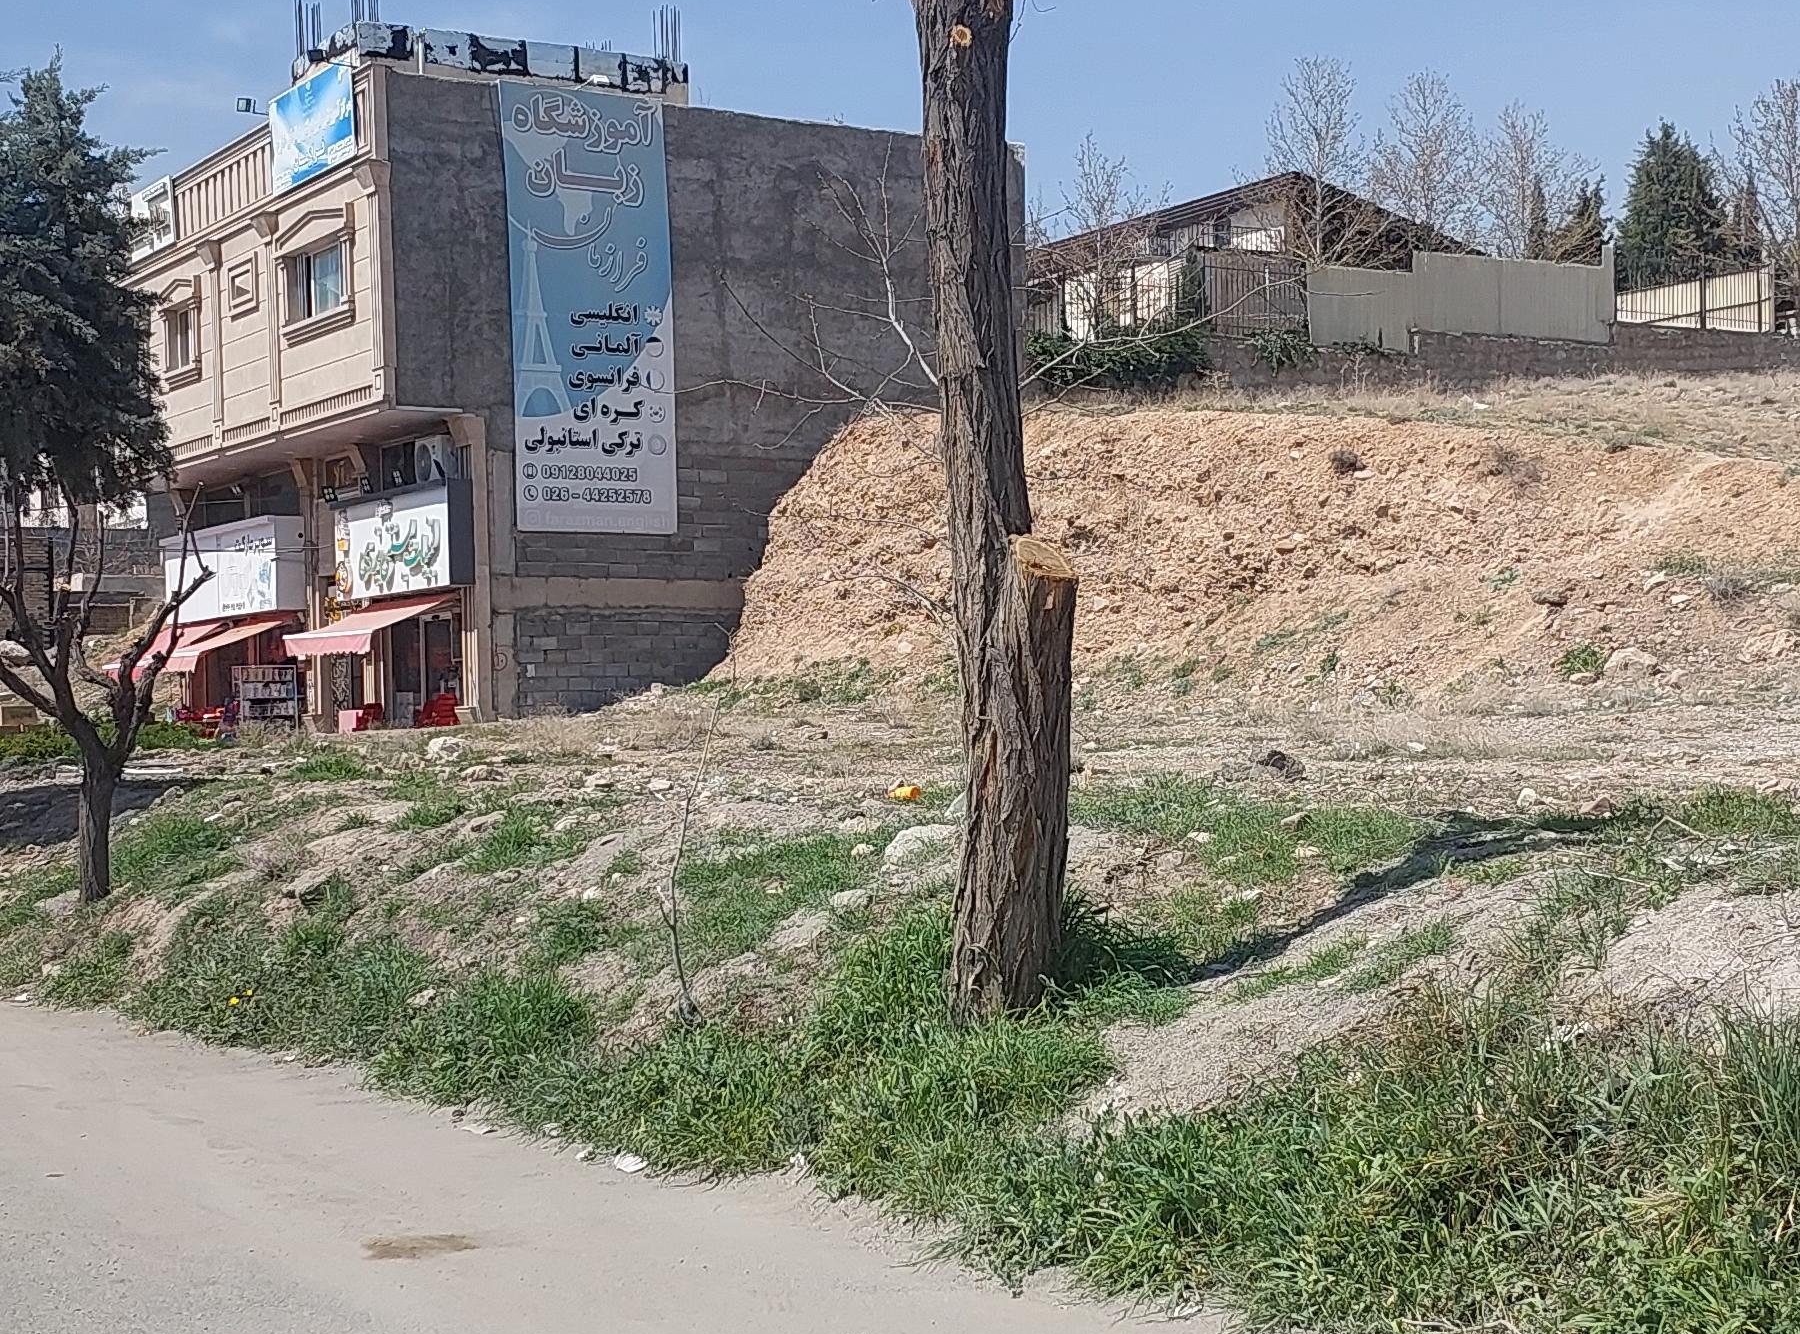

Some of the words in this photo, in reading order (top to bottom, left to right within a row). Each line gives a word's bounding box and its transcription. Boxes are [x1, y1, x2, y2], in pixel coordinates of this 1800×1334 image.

[512, 94, 656, 154] آموزشگاه
[526, 148, 644, 207] زبان
[570, 303, 639, 327] انگلیسی
[571, 333, 641, 357] آلمانی
[569, 366, 640, 393] فرانسوی
[573, 398, 597, 421] ای
[601, 399, 644, 423] کره
[524, 427, 598, 454] استانبولی
[602, 430, 643, 455] ترکی
[541, 465, 638, 482] 09128044025
[542, 487, 570, 502] 026
[582, 488, 652, 504] 44252578
